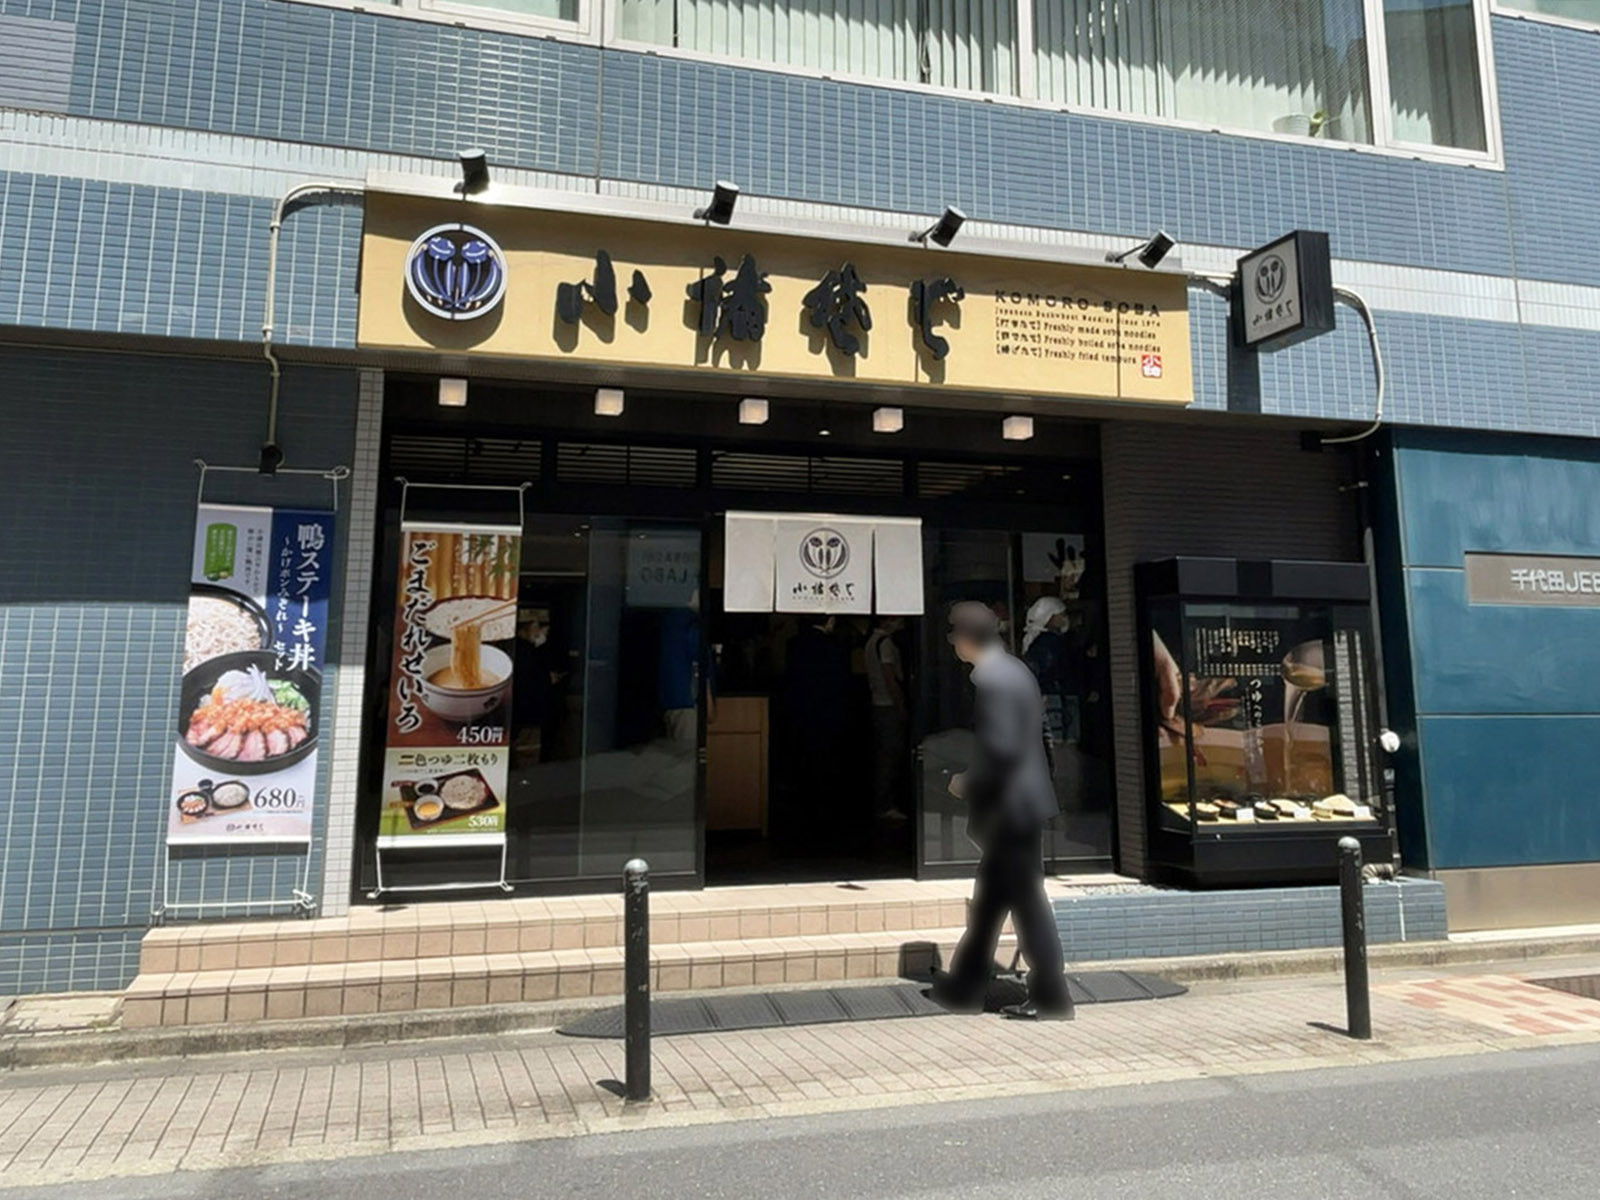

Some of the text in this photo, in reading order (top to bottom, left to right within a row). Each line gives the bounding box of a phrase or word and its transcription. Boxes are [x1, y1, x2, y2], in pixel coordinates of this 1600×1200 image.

[1044, 322, 1074, 334] Freshly
[1078, 326, 1100, 335] made
[1124, 330, 1156, 340] noodles
[1044, 334, 1075, 347] Freshly
[1078, 338, 1104, 349] boiled
[1128, 343, 1161, 353] noodles
[1045, 348, 1076, 361] Freshly
[1078, 351, 1099, 361] fried
[1101, 353, 1136, 365] tempura
[286, 524, 326, 672] 鴨ステーキ丼
[396, 538, 437, 733] ごまだれせいろ
[398, 752, 499, 767] 二色つゆ二枚もり
